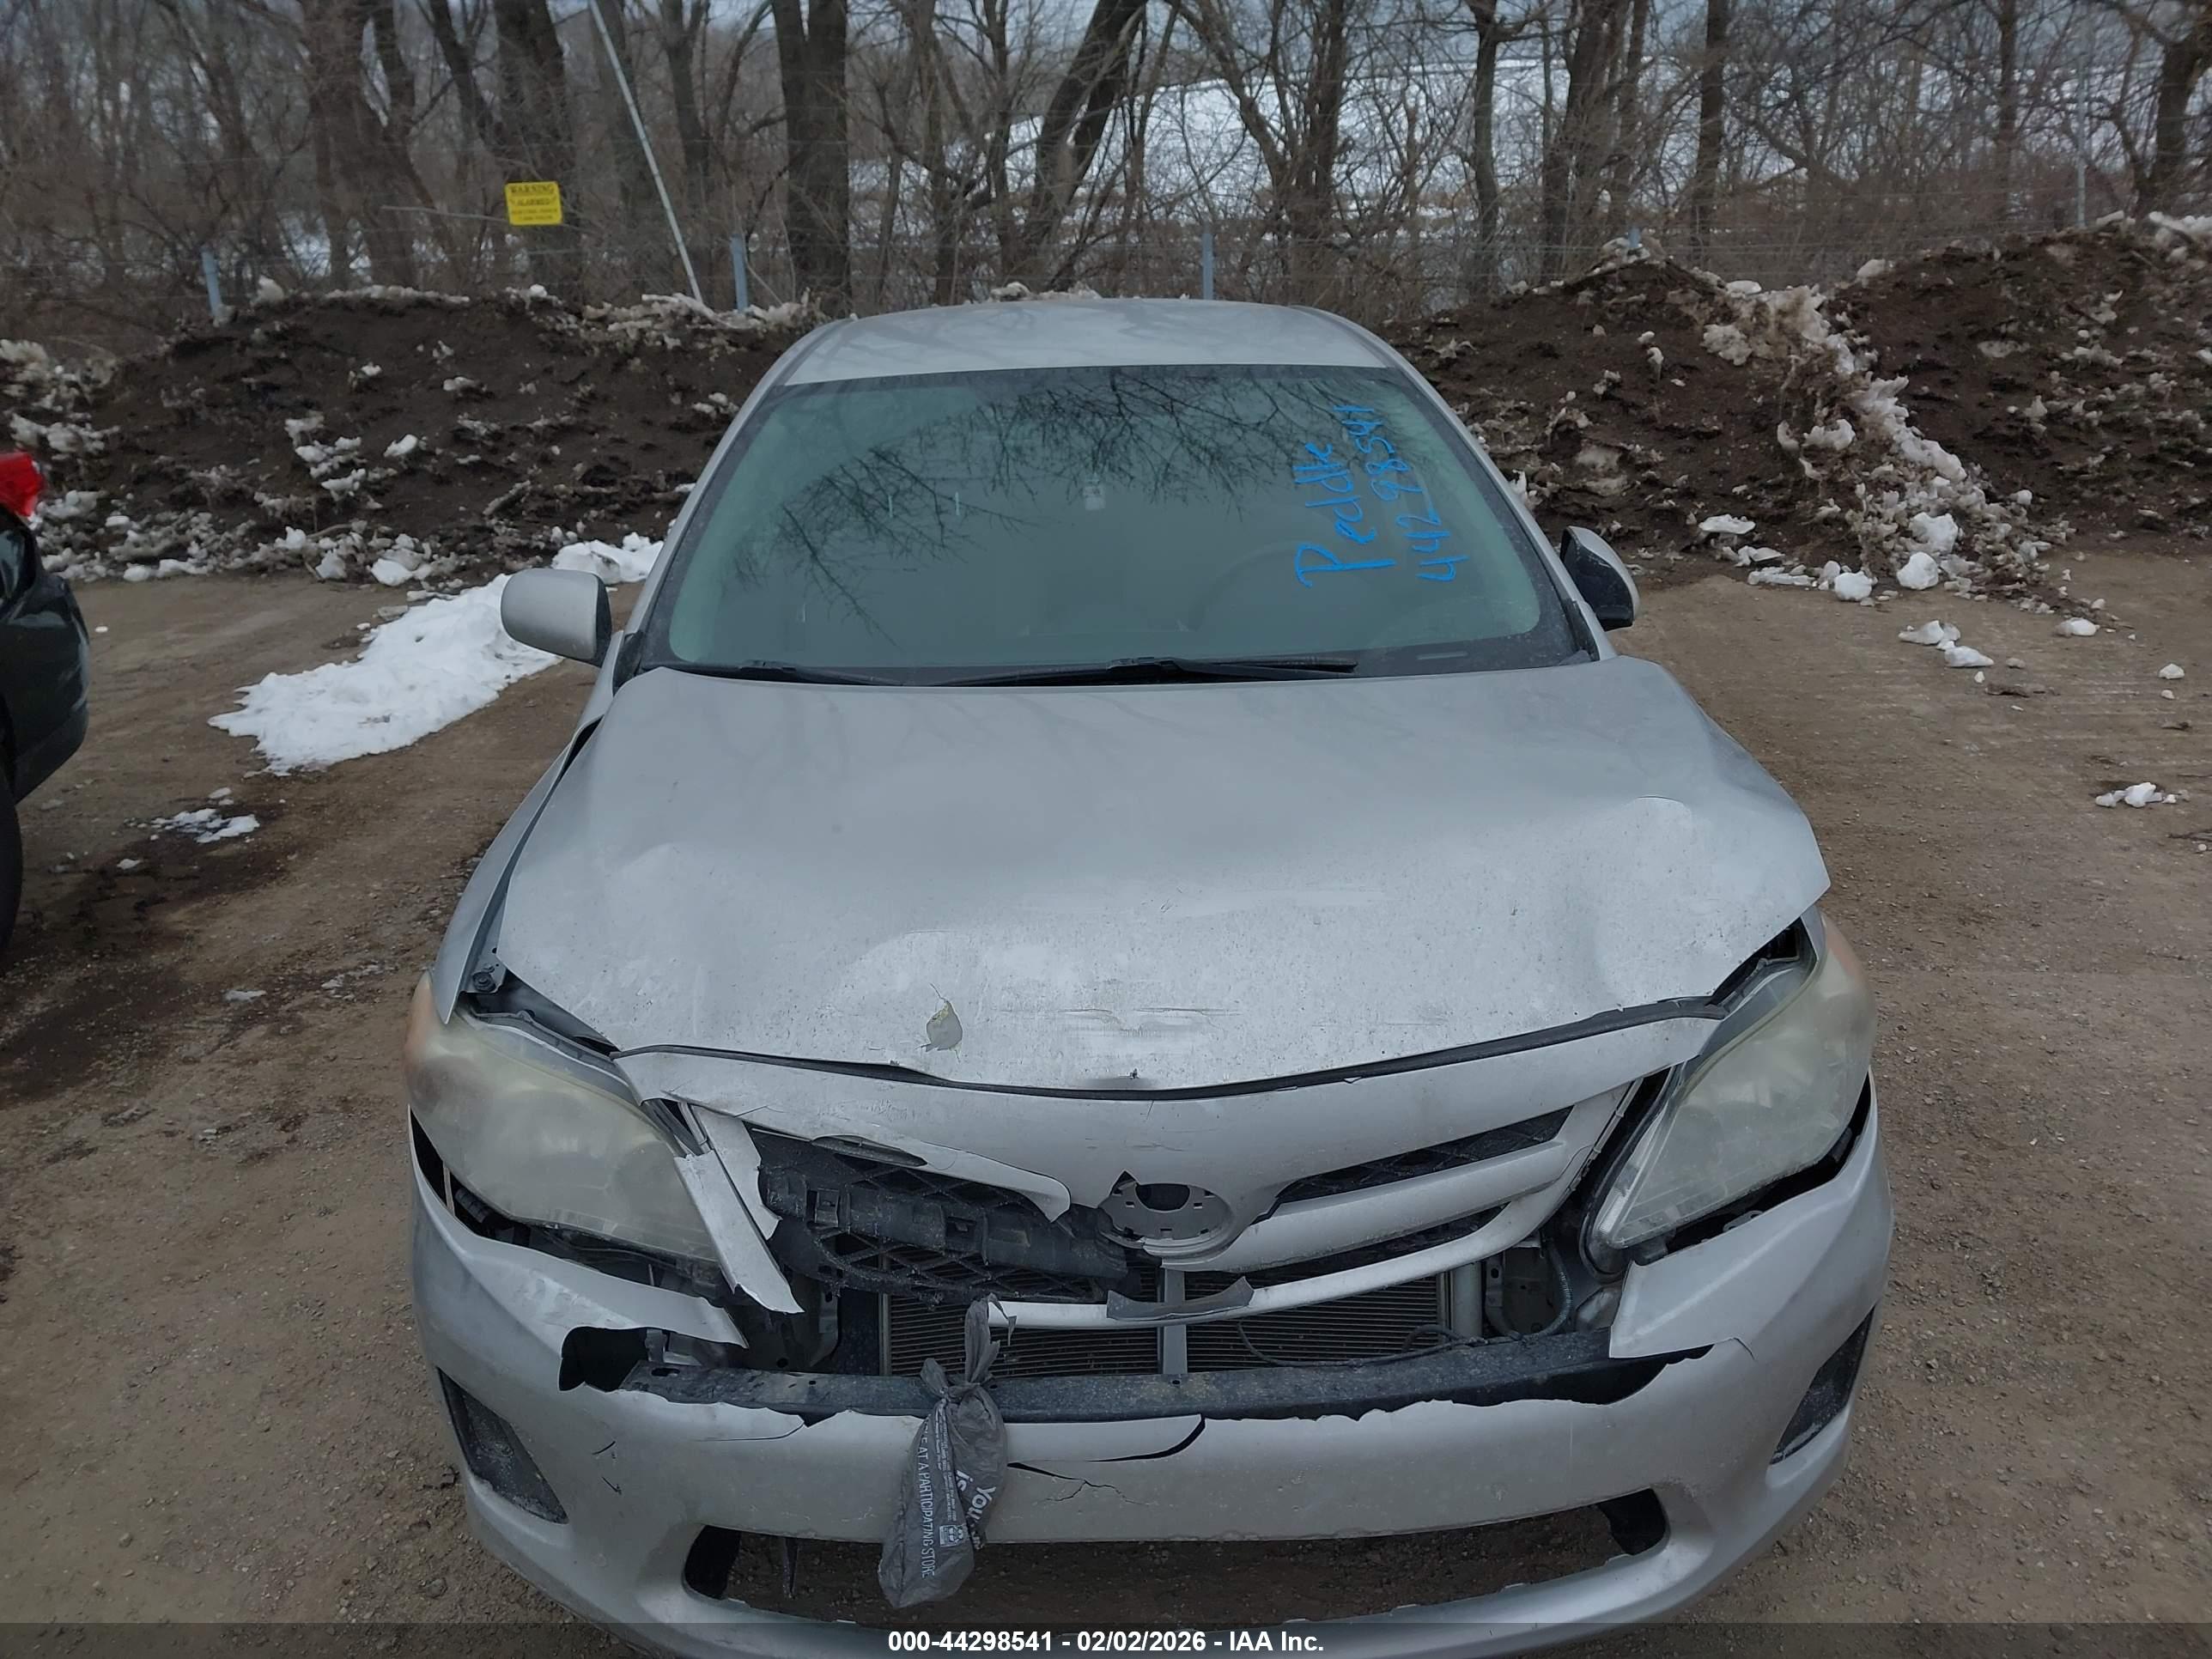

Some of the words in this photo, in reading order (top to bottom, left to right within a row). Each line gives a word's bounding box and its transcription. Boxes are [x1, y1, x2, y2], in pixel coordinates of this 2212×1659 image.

[917, 1447, 929, 1460] AT
[918, 1462, 929, 1471] A
[919, 1473, 934, 1547] PARTICIPATING
[921, 1547, 935, 1578] STORE
